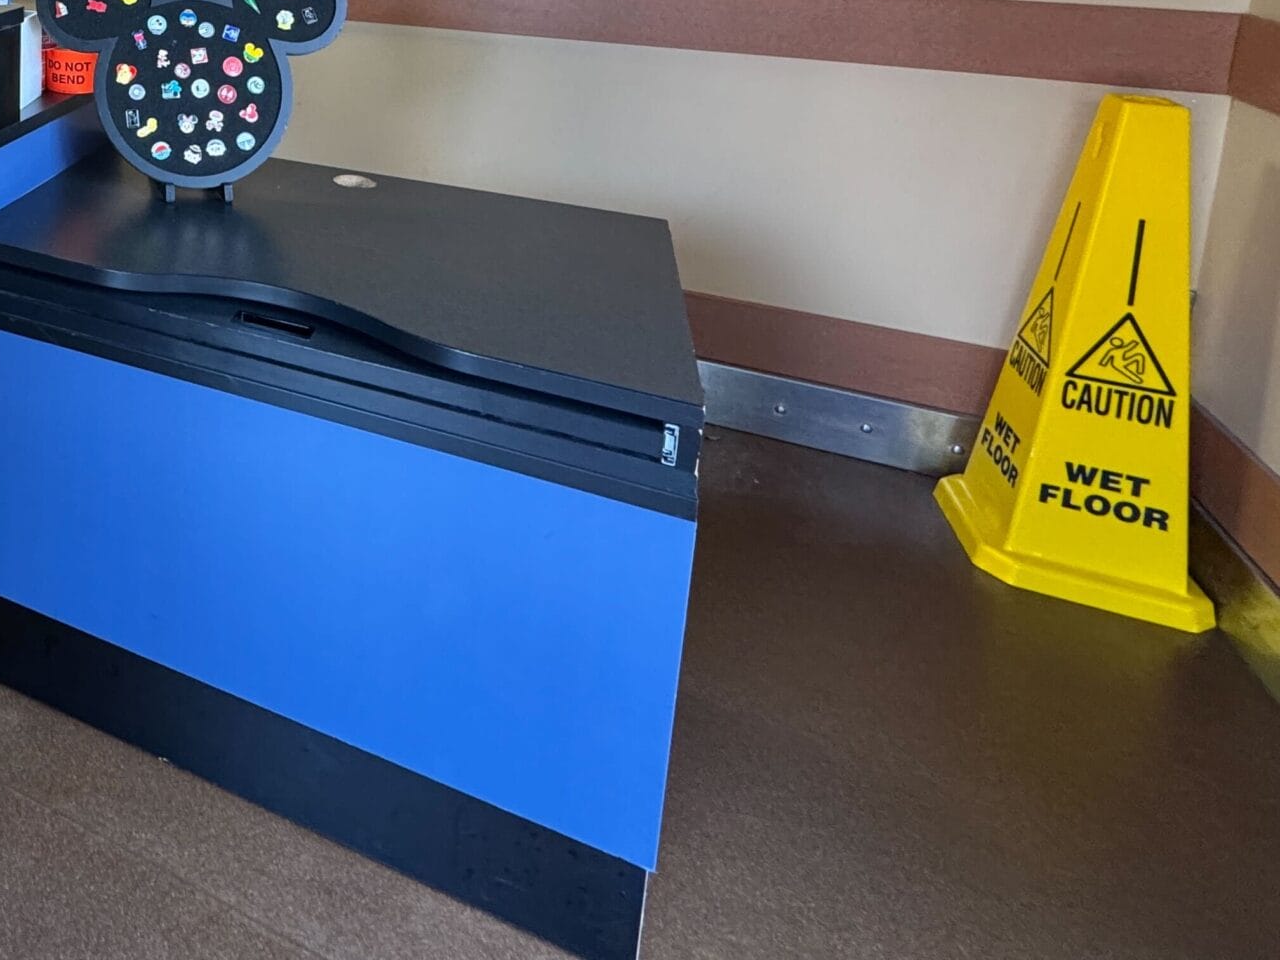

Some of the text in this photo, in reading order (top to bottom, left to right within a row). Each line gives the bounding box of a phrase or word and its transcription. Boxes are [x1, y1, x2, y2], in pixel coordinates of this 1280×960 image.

[47, 59, 92, 72] DO NOT
[52, 73, 85, 85] BEND
[1009, 339, 1048, 397] CAUTION
[1061, 380, 1175, 429] CAUTION
[995, 412, 1021, 454] WET
[981, 427, 1019, 488] FLOOR
[1065, 461, 1151, 497] WET
[1038, 483, 1170, 532] FLOOR
